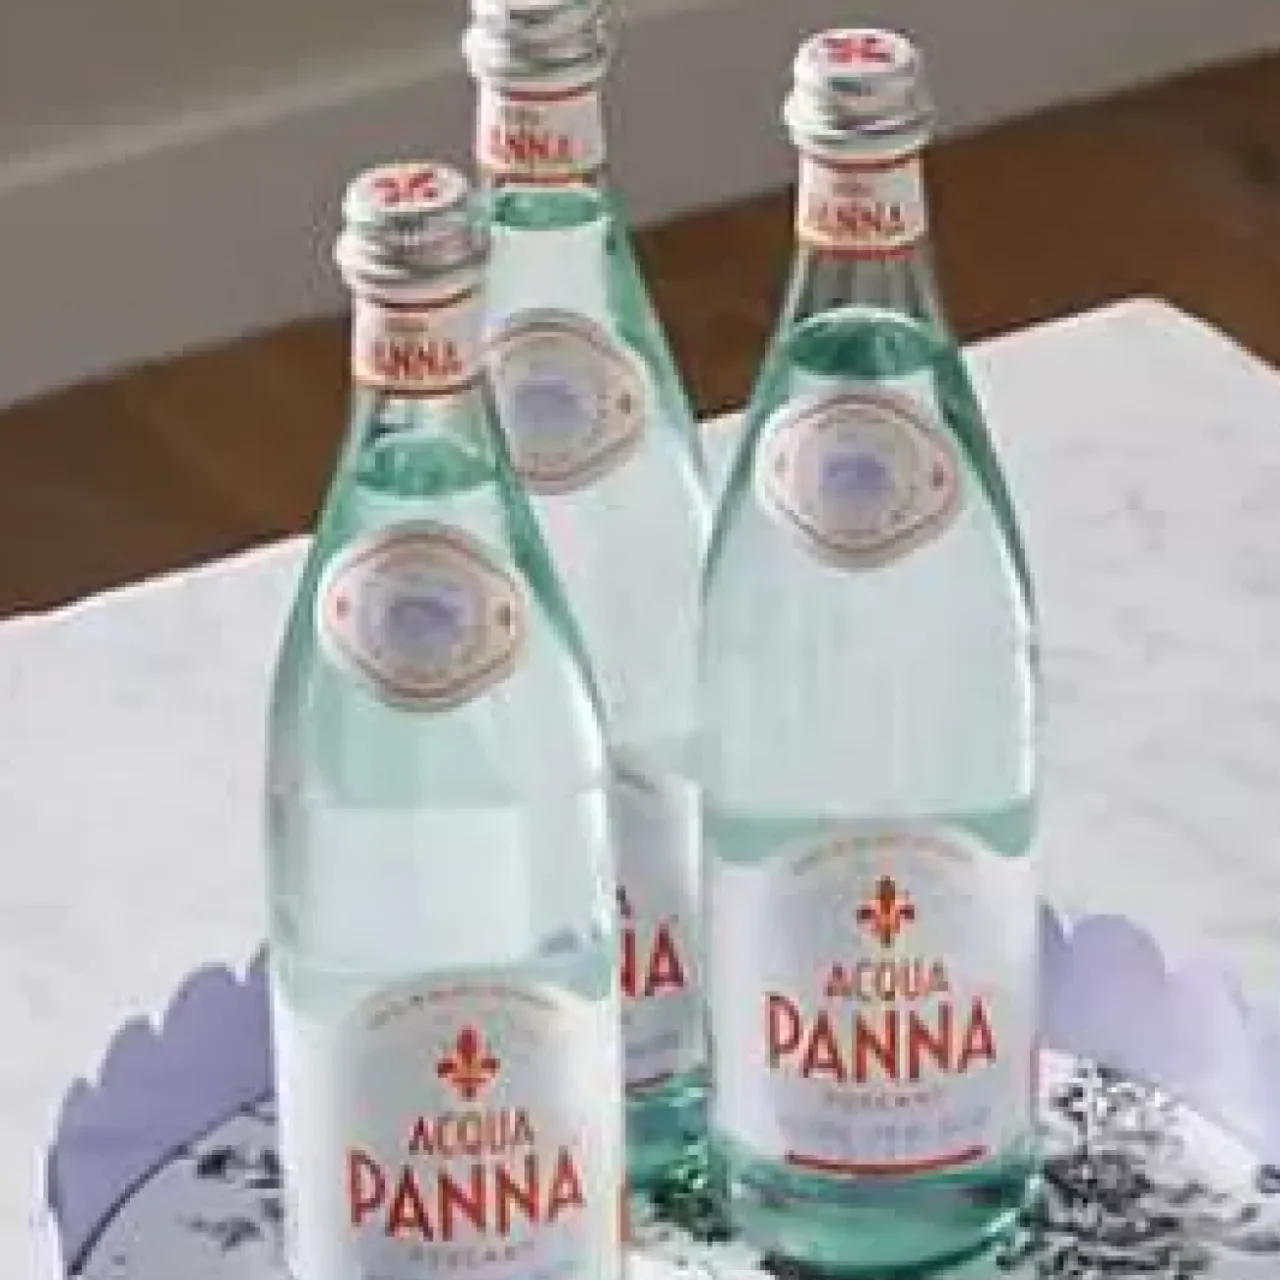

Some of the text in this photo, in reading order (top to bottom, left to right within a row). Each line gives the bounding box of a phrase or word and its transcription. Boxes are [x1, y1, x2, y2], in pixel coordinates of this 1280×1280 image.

[824, 957, 949, 1000] ACQUA
[765, 992, 997, 1083] PANNA
[408, 1107, 535, 1156] ACQUA
[350, 1148, 588, 1242] PANNA
